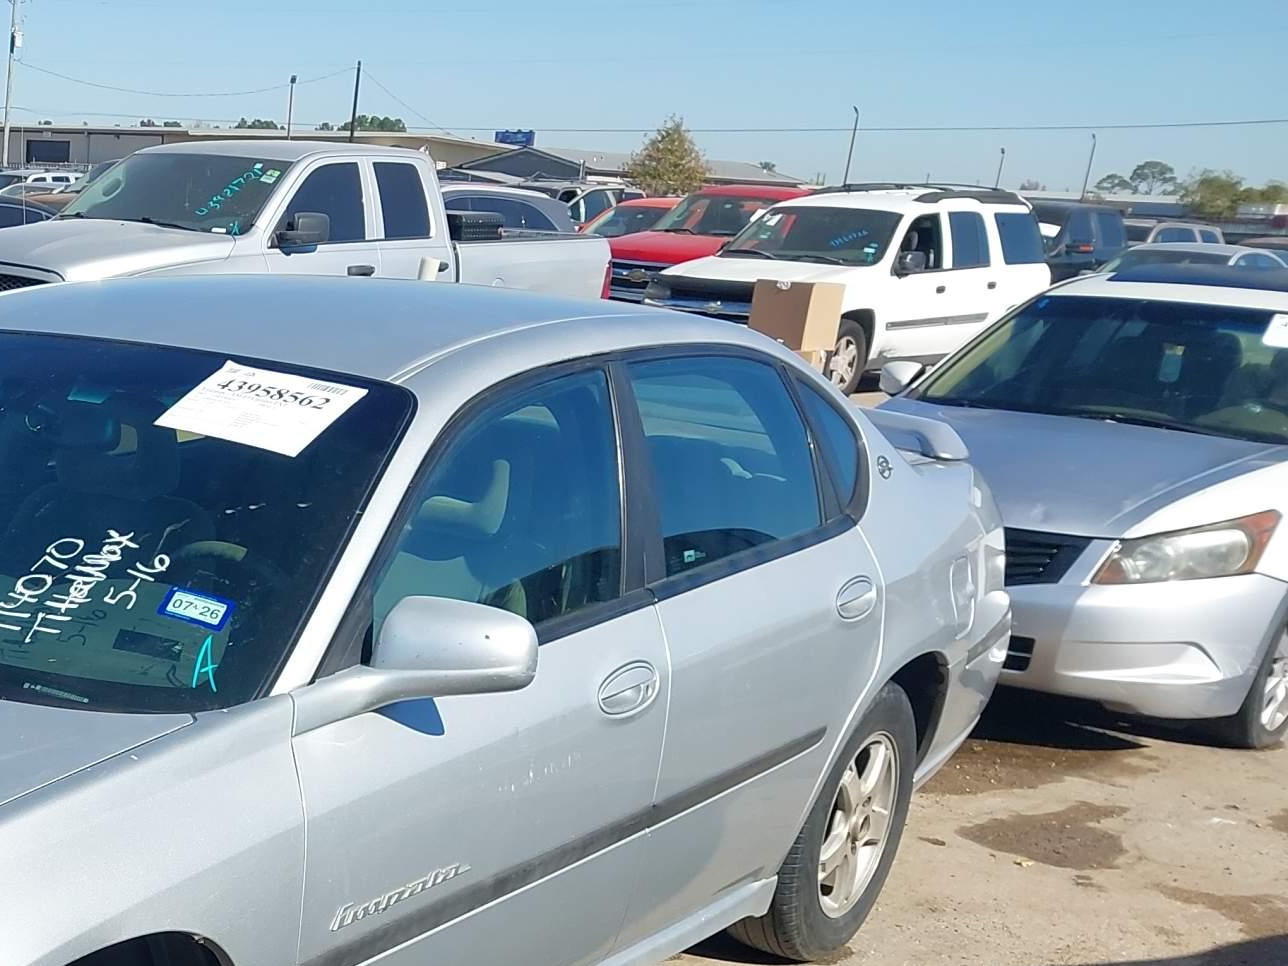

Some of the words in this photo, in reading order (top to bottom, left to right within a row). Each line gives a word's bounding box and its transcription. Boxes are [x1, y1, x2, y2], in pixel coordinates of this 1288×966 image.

[216, 378, 331, 411] 43958562
[103, 553, 171, 610] 5-16
[172, 598, 194, 611] 07
[198, 605, 221, 620] 26
